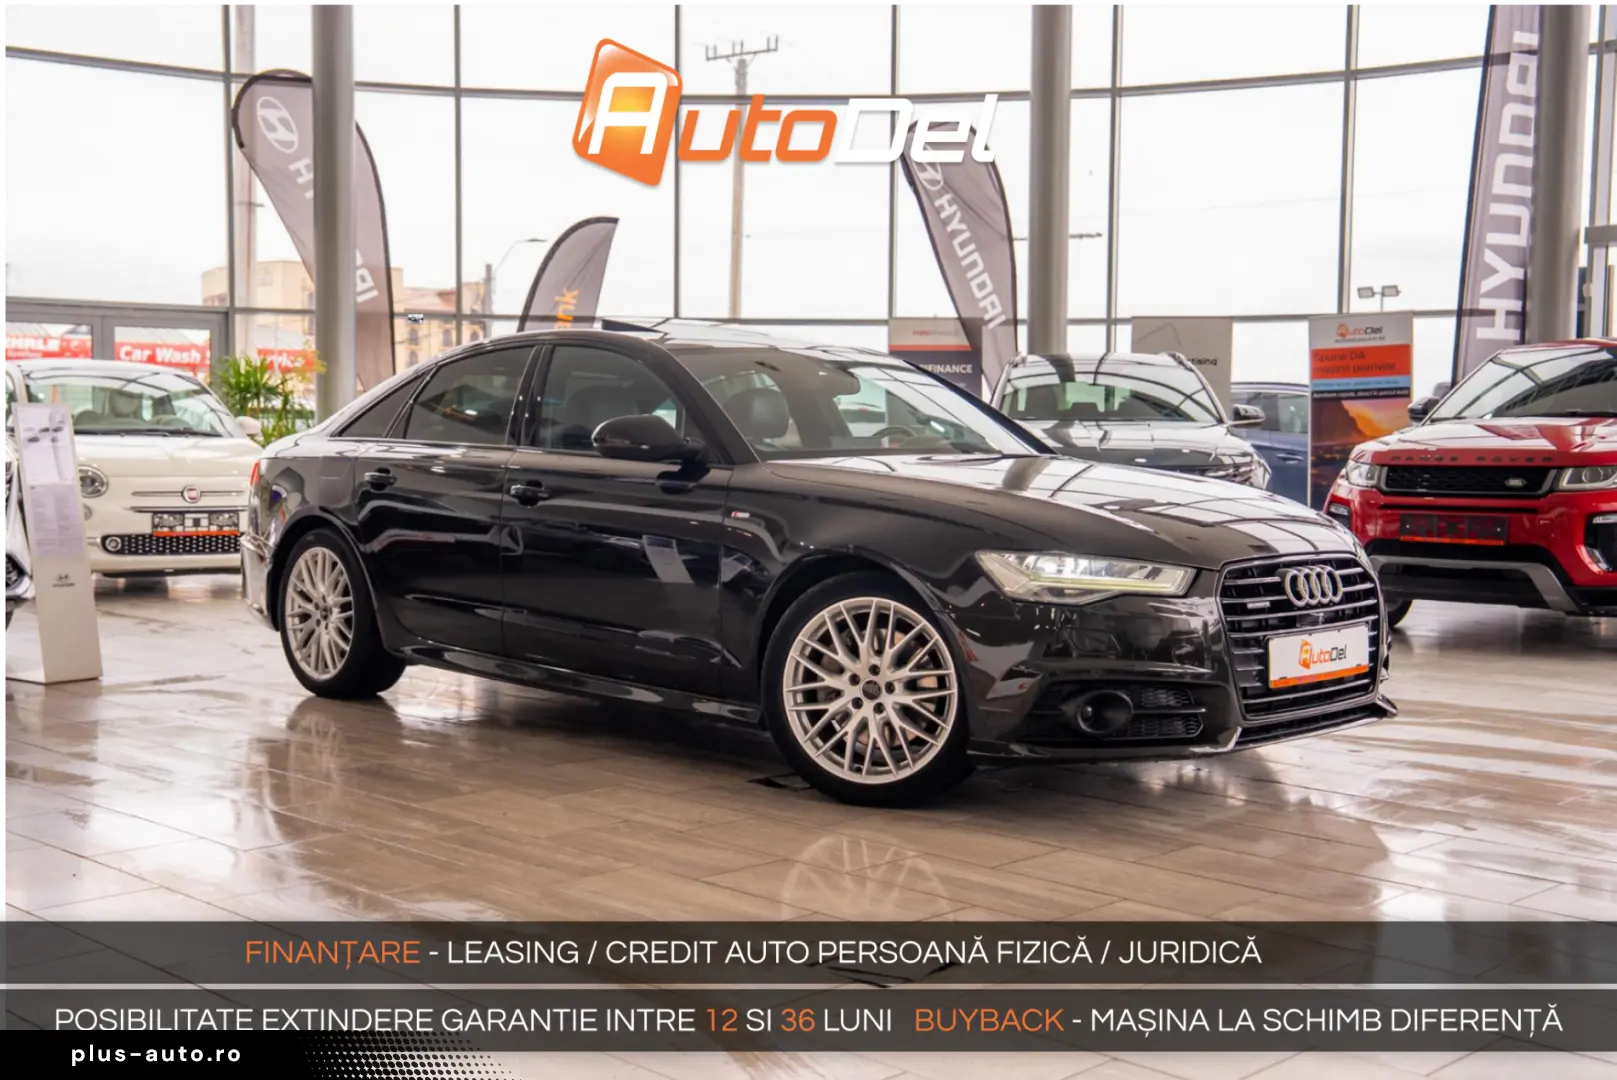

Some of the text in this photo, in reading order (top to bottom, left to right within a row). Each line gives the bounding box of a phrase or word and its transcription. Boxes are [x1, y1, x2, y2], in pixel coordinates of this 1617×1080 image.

[1476, 30, 1539, 341] HYUNDAI
[934, 193, 1006, 330] HYUNDAI
[119, 345, 152, 361] Car
[156, 346, 201, 364] Wash
[1299, 641, 1348, 668] AutoDel
